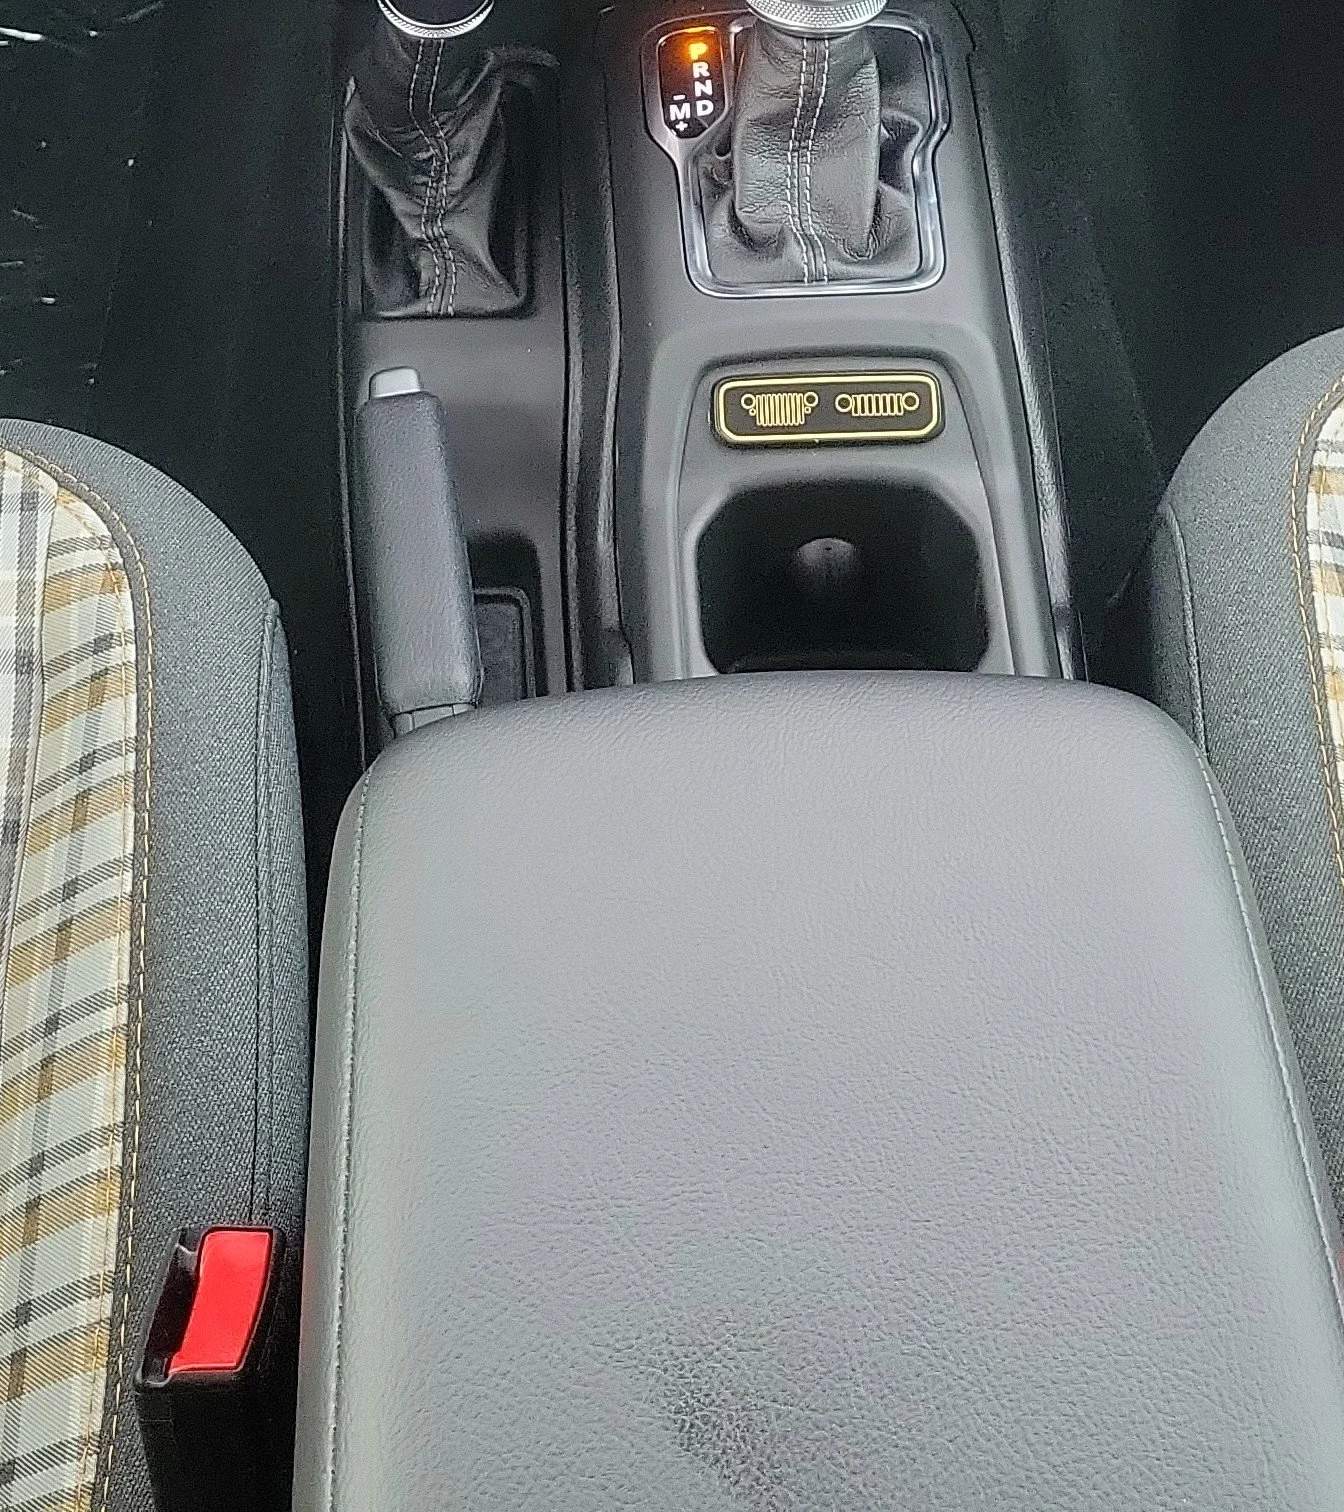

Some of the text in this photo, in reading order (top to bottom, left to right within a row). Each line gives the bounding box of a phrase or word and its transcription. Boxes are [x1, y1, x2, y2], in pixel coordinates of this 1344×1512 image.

[689, 42, 708, 60] P
[692, 61, 711, 79] R
[694, 79, 713, 97] N
[669, 102, 691, 121] M
[695, 99, 714, 117] D
